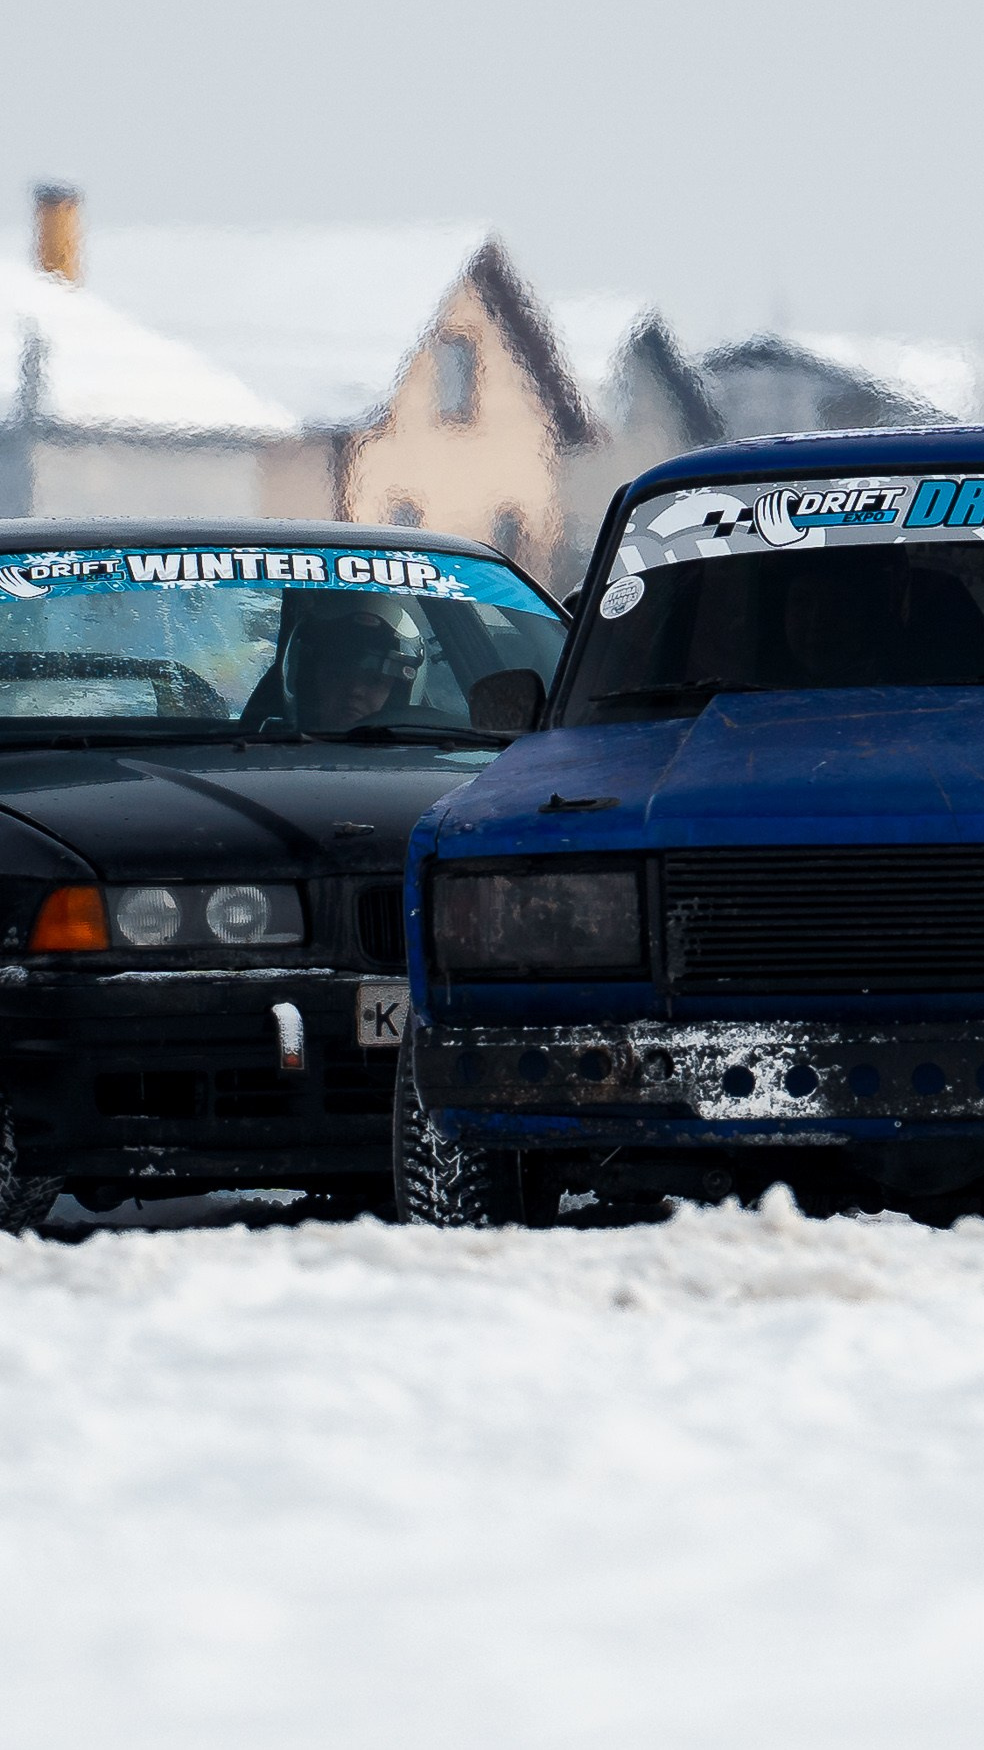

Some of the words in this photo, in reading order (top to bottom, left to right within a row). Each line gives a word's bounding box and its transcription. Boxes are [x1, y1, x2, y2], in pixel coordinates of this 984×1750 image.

[797, 487, 906, 515] DRIFT
[843, 511, 886, 523] EXPO
[31, 559, 120, 580] DRIFT
[127, 552, 328, 583] WINTER
[335, 556, 442, 589] CUP
